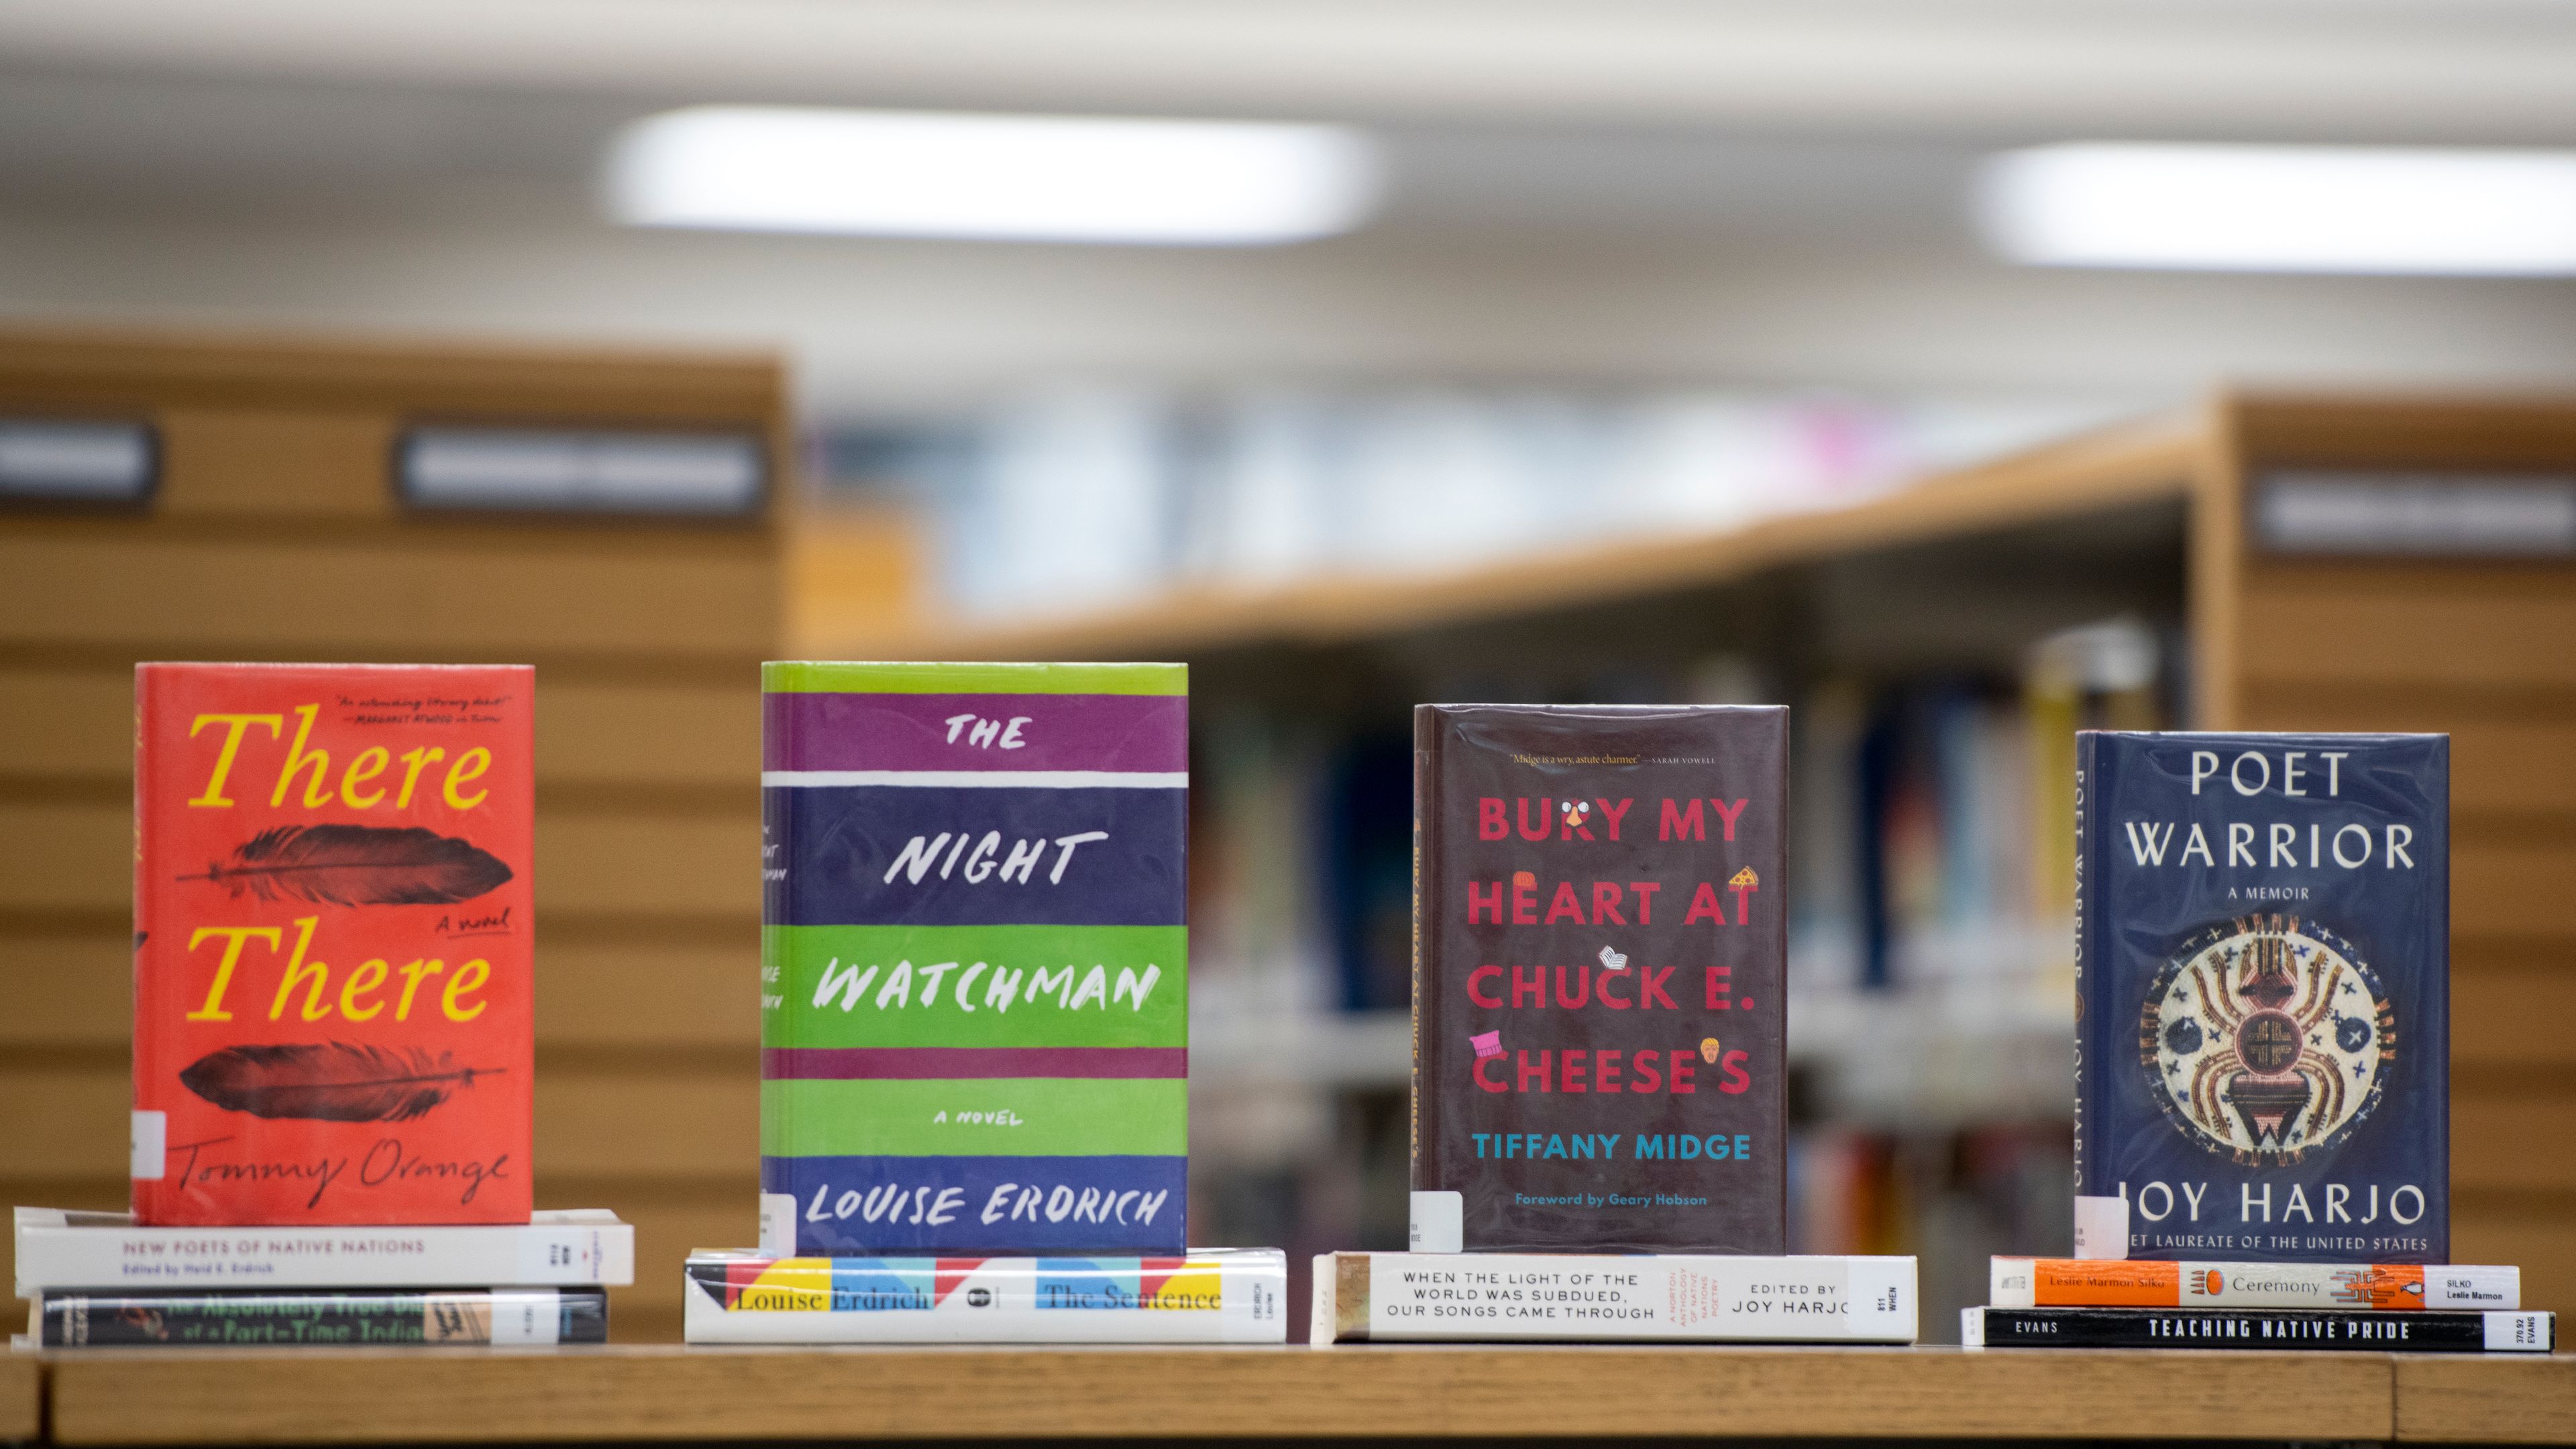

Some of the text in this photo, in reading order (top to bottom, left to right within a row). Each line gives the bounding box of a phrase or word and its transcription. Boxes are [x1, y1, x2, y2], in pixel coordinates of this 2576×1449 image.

[945, 714, 1033, 749] THE
[188, 703, 492, 810] There
[1542, 755, 1550, 763] is
[1556, 757, 1575, 767] wry,
[1576, 755, 1601, 763] astute
[2191, 750, 2349, 797] POET
[1478, 797, 1750, 842] BURY MY
[883, 830, 1110, 885] NIGHT
[2125, 822, 2415, 869] WARRIOR
[2074, 770, 2084, 978] POET WARRIOR
[1468, 881, 1760, 926] HEART AT
[2228, 887, 2310, 900] A MEMOIR
[435, 906, 511, 933] A novel
[186, 914, 491, 1023] There
[812, 957, 1162, 1013] WATCHMAN
[1412, 979, 1419, 999] AT
[1466, 964, 1756, 1010] CHUCK E.
[1472, 1049, 1752, 1094] CHEESES
[933, 1109, 1024, 1127] A NOVEL
[1471, 1132, 1751, 1160] TIFFANY MIDGE
[166, 1136, 510, 1209] Tommy Orange
[805, 1183, 965, 1226] LOUISE
[980, 1183, 1169, 1227] ERDRICH
[1515, 1192, 1707, 1208] Foreword by Geary Hobson
[2241, 1182, 2426, 1225] HARJO
[123, 1240, 425, 1255] NEW POETS OF NATIVE NATIONS
[2155, 1234, 2235, 1248] LAUREATE
[2241, 1236, 2262, 1248] OF
[2269, 1236, 2300, 1249] THE
[2306, 1236, 2365, 1250] UNITED
[2373, 1237, 2427, 1251] STATES
[123, 1263, 161, 1275] Edited
[164, 1263, 179, 1276] by
[1403, 1272, 1639, 1286] WHEN THE LIGHT OF THE
[1751, 1284, 1836, 1295] EDITED BY
[2050, 1276, 2165, 1289] Leslie Marmon Silko
[2233, 1276, 2320, 1296] Ceremony
[2447, 1279, 2471, 1288] SILKO
[737, 1286, 930, 1311] Louise Erdrich
[1045, 1283, 1222, 1309] The Sentence
[1414, 1289, 1628, 1303] WORLD WAS SUBDUED,
[1732, 1301, 1772, 1313] JOY
[1888, 1287, 1896, 1311] WHEN
[2447, 1291, 2503, 1300] Leslie Marmon
[203, 1294, 326, 1325] Absolutely
[334, 1294, 387, 1316] True
[1387, 1305, 1655, 1319] OUR SONGS CAME THROUGH
[1690, 1309, 1697, 1323] OF
[184, 1324, 202, 1340] of
[224, 1319, 352, 1340] Part-Time
[359, 1319, 424, 1340] India
[2016, 1321, 2058, 1333] EVANS
[2150, 1318, 2410, 1339] TEACHING NATIVE PRIDE
[2516, 1319, 2524, 1344] 370.92
